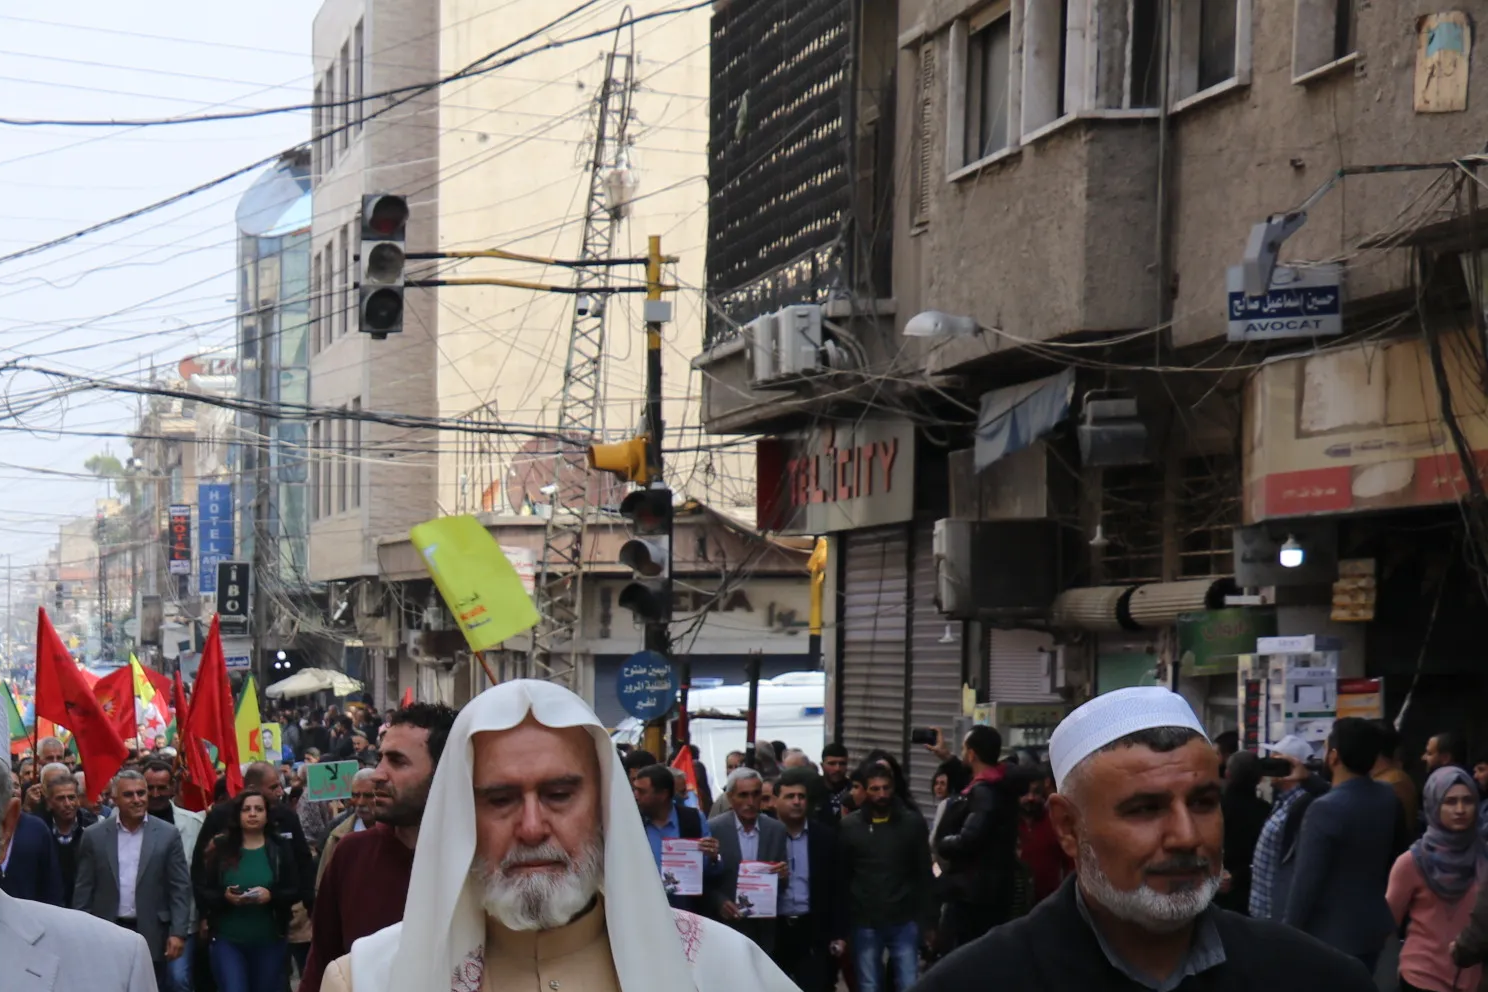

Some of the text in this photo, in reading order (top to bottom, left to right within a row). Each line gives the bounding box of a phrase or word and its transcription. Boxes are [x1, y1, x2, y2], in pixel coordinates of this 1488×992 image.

[1307, 292, 1334, 309] حسين
[1246, 320, 1322, 332] AVOCAT
[209, 490, 220, 553] HOTEL
[173, 515, 187, 560] HOTEL
[624, 665, 670, 676] اليمين مفتوح
[624, 681, 643, 693] المرور
[325, 764, 337, 780] لا
